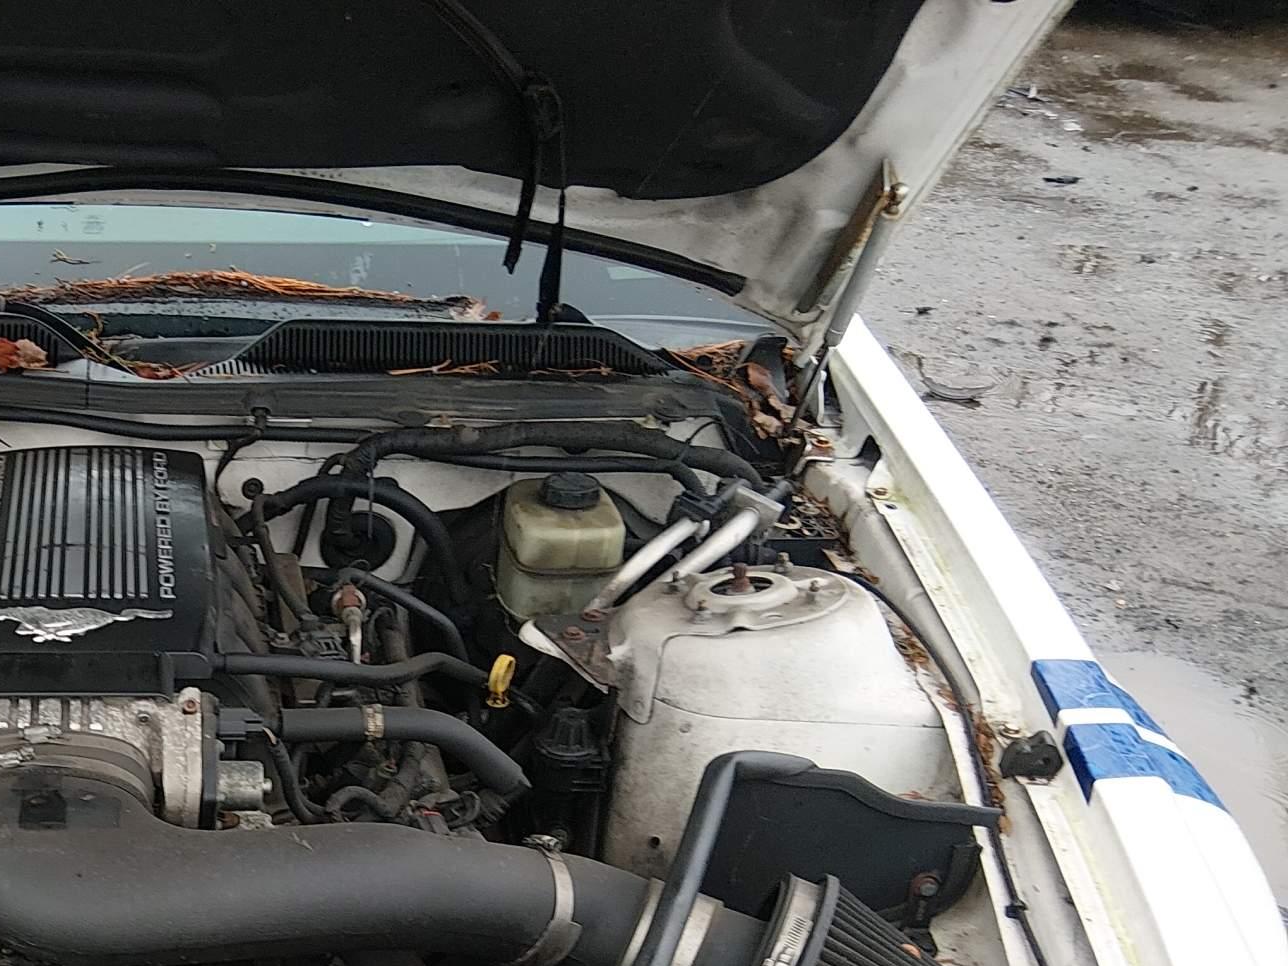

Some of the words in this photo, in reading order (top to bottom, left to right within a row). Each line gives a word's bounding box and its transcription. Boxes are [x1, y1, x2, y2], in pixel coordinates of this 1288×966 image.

[152, 451, 169, 489] FORD
[154, 490, 171, 514] BY
[156, 516, 177, 599] POWERED
